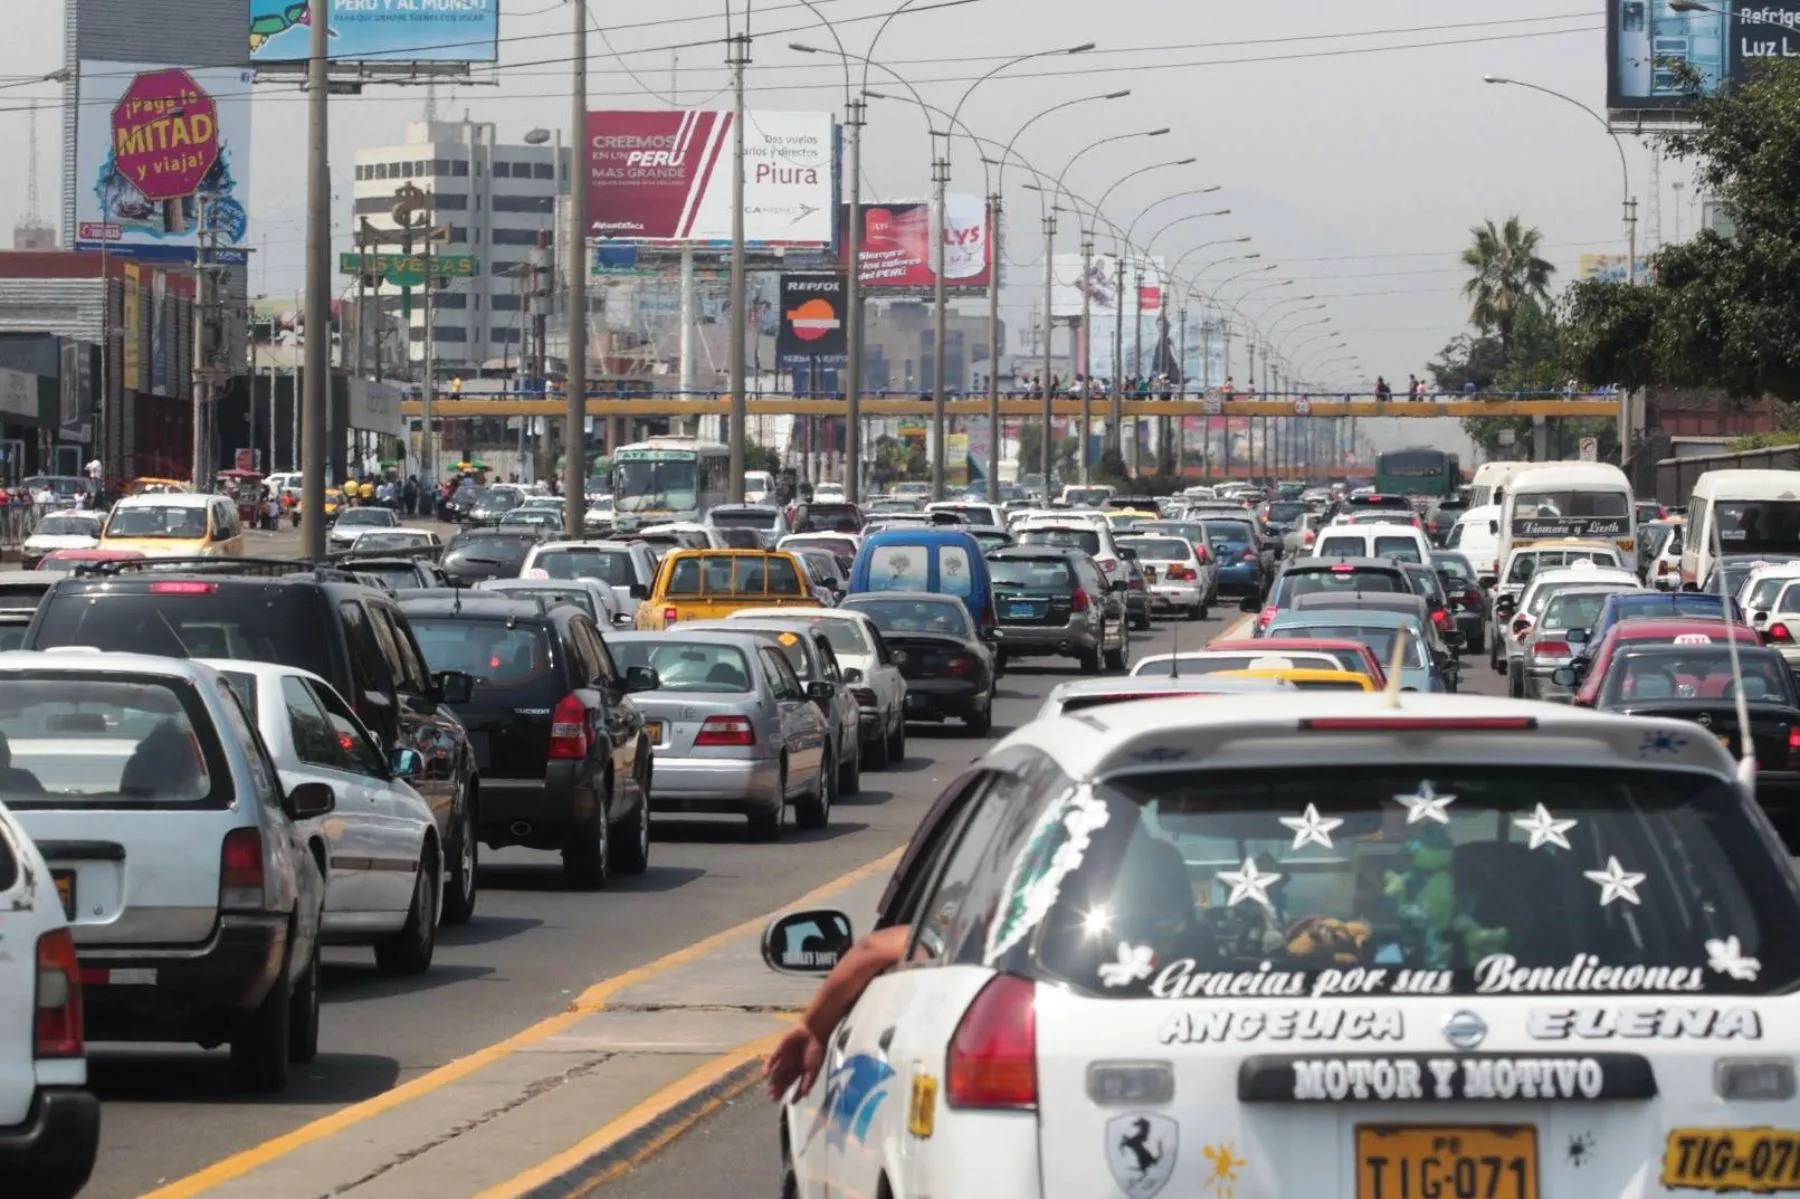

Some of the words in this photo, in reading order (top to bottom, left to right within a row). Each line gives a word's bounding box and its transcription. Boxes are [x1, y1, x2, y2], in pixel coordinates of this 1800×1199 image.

[383, 0, 392, 10] Y
[397, 0, 418, 10] AL
[422, 0, 486, 10] MUNDO
[1741, 36, 1777, 57] Luz
[126, 96, 175, 119] ¡Paga
[180, 89, 198, 105] la
[118, 114, 213, 157] MITAD
[592, 135, 678, 148] CREEMOS
[764, 134, 784, 144] Dos
[786, 134, 818, 144] vuelos
[592, 151, 609, 160] EN
[778, 146, 818, 157] directos
[137, 164, 147, 181] y
[153, 152, 203, 174] viaja!
[627, 167, 685, 178] GRANDE
[756, 161, 818, 185] Piura
[394, 257, 472, 272] VEGAS
[787, 281, 840, 291] REPSOL
[1574, 526, 1582, 535] y
[1149, 958, 1306, 998] Gracias
[1311, 967, 1387, 998] por
[1390, 969, 1455, 994] sus
[1474, 953, 1706, 994] Bendiciones
[1158, 1006, 1405, 1045] ANGELICA
[1527, 1006, 1763, 1041] ELENA
[1292, 1057, 1423, 1100] MOTOR
[1427, 1057, 1458, 1099] Y
[1462, 1057, 1604, 1100] MOTIVO
